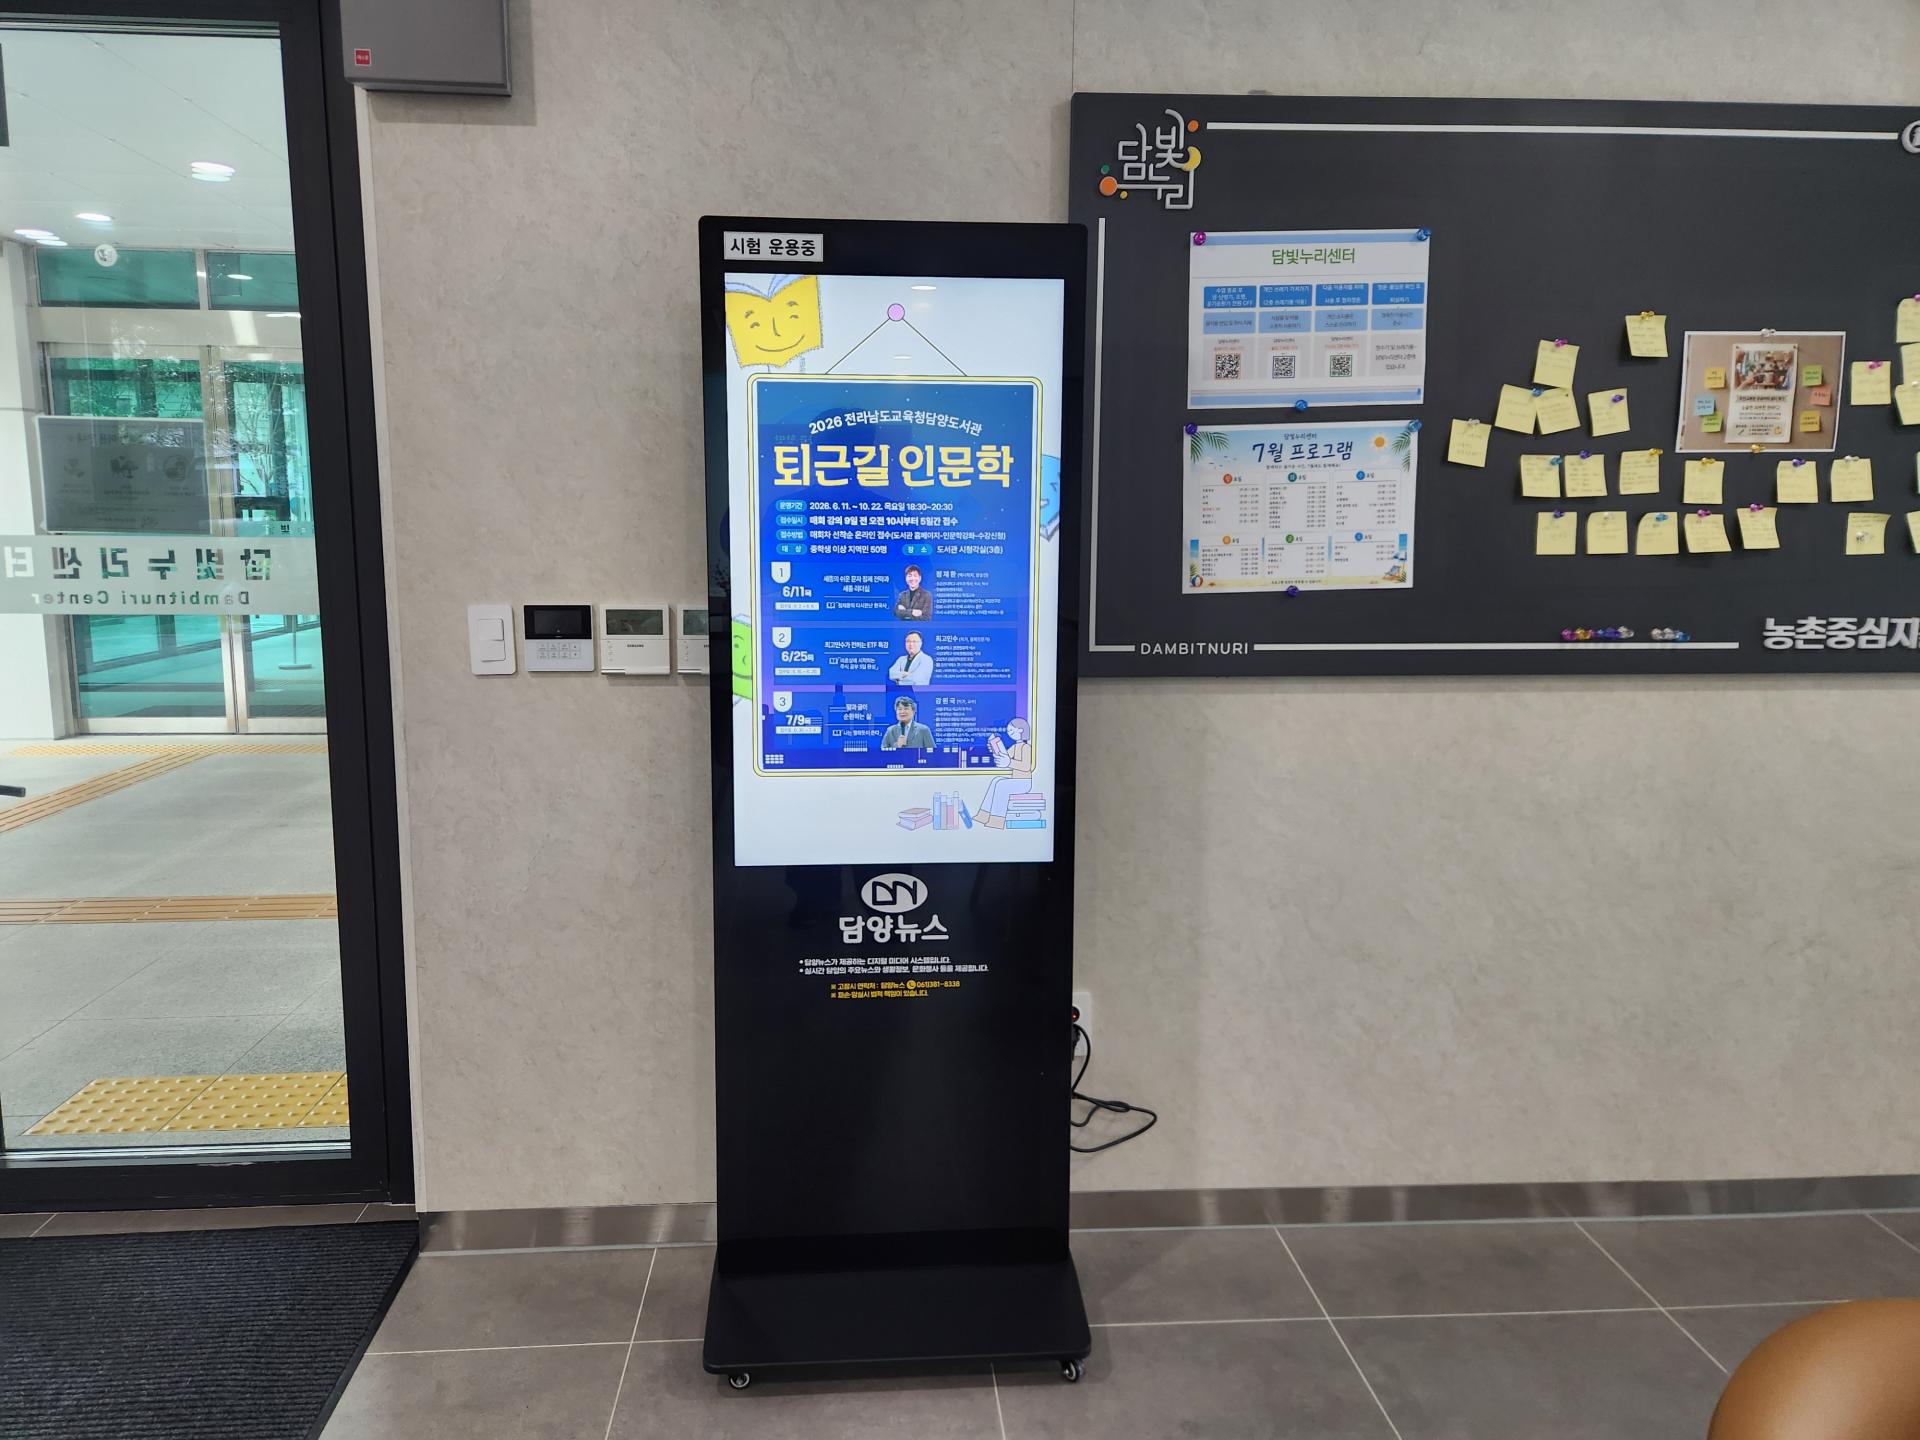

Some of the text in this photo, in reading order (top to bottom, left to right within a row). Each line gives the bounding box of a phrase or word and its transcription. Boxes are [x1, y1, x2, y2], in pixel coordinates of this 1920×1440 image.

[730, 237, 816, 256] 시험 운용중
[1272, 248, 1355, 265] 담빛누리센터
[809, 409, 983, 437] 2026 전라남도교육청담양도서관
[1252, 440, 1354, 463] 7월 프로그램
[773, 443, 1014, 488] 퇴근길 인문학
[778, 633, 786, 643] 2
[1763, 616, 1920, 650] 농촌중심지
[1140, 642, 1248, 655] DAMBITNURI
[779, 697, 786, 707] 3
[839, 914, 949, 944] 담양뉴스
